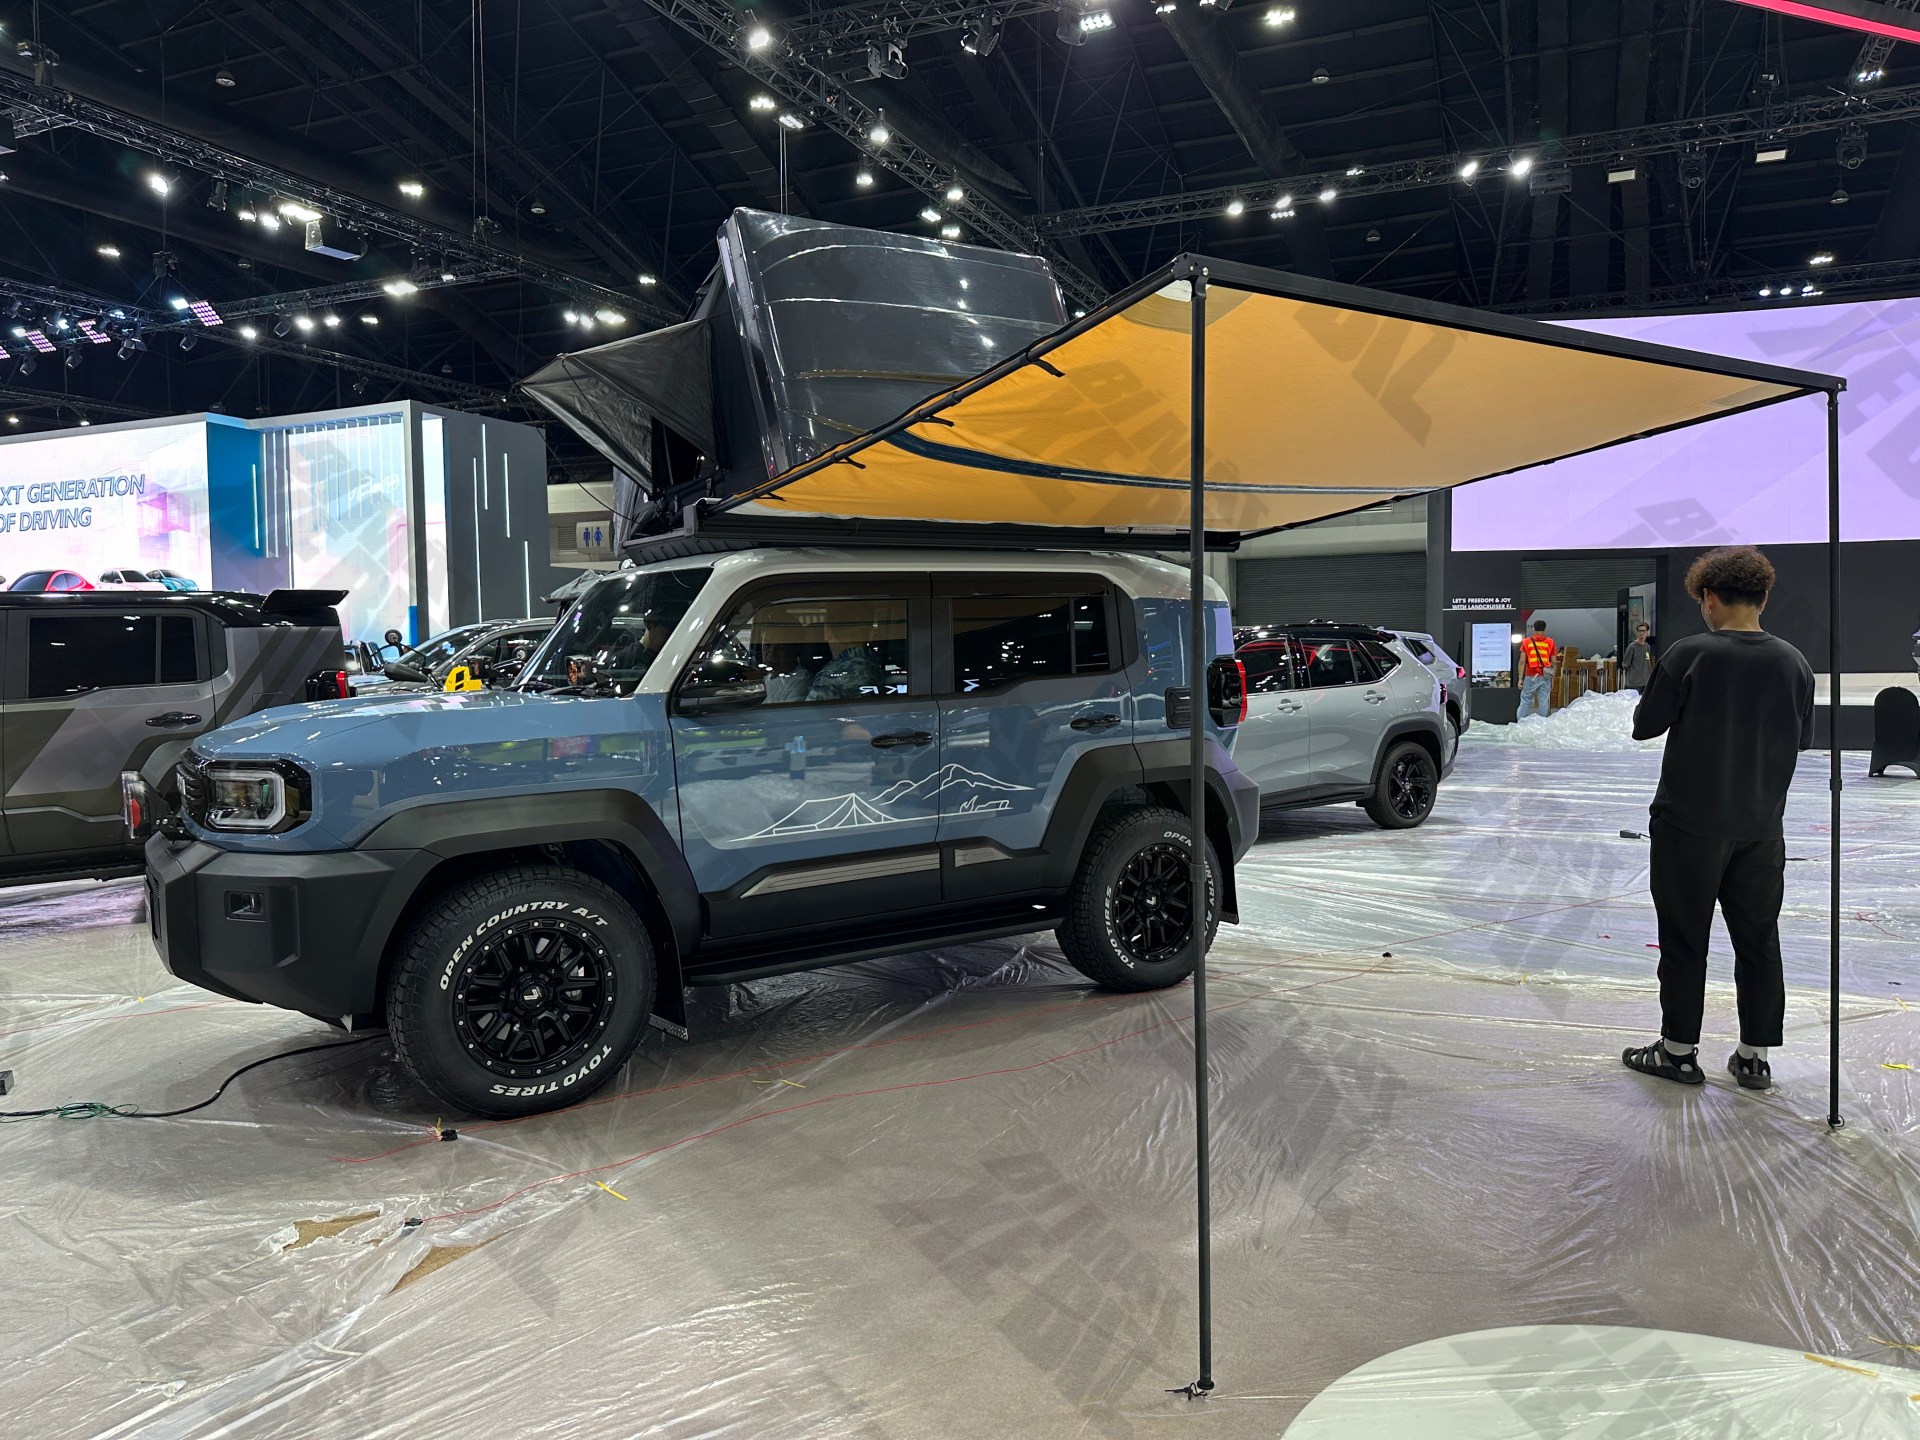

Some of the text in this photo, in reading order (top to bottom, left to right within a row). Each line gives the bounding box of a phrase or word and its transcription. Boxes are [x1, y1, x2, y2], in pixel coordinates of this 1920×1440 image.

[27, 473, 146, 504] GENERATION
[19, 506, 92, 532] DRIVING
[439, 901, 608, 990] OPEN COUNTRY A/T
[1104, 885, 1136, 969] TOYO TIRES
[490, 1044, 613, 1097] TOYO TIRES
